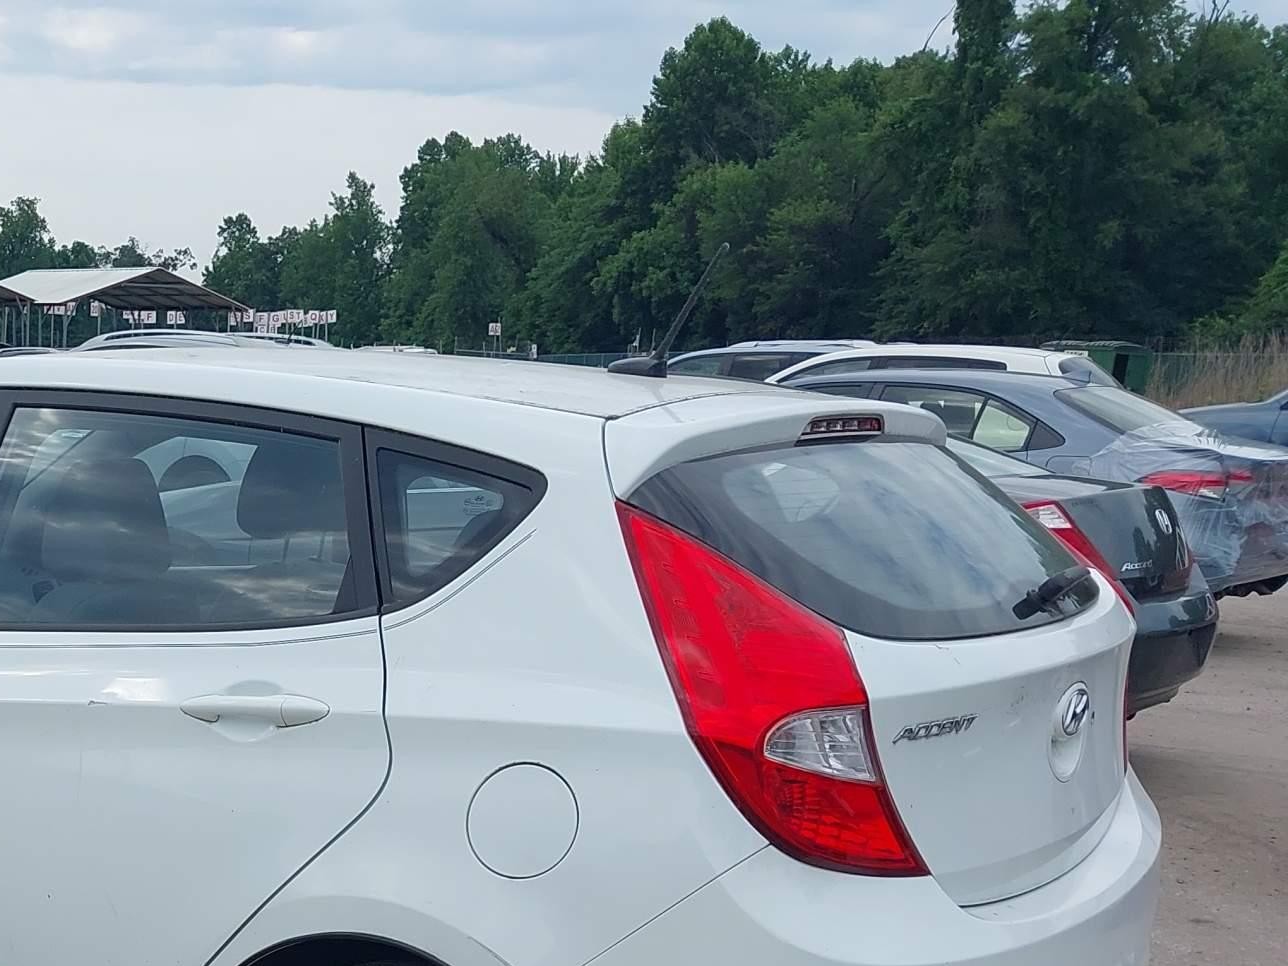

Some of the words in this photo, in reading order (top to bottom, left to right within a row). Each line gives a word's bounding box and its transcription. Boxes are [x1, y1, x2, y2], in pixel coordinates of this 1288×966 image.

[147, 312, 153, 321] F
[272, 314, 280, 323] G
[289, 311, 294, 320] S
[295, 312, 301, 321] T
[310, 312, 317, 321] Q
[329, 312, 335, 321] Y
[1120, 559, 1153, 572] Accord
[892, 714, 979, 744] ACCENT
